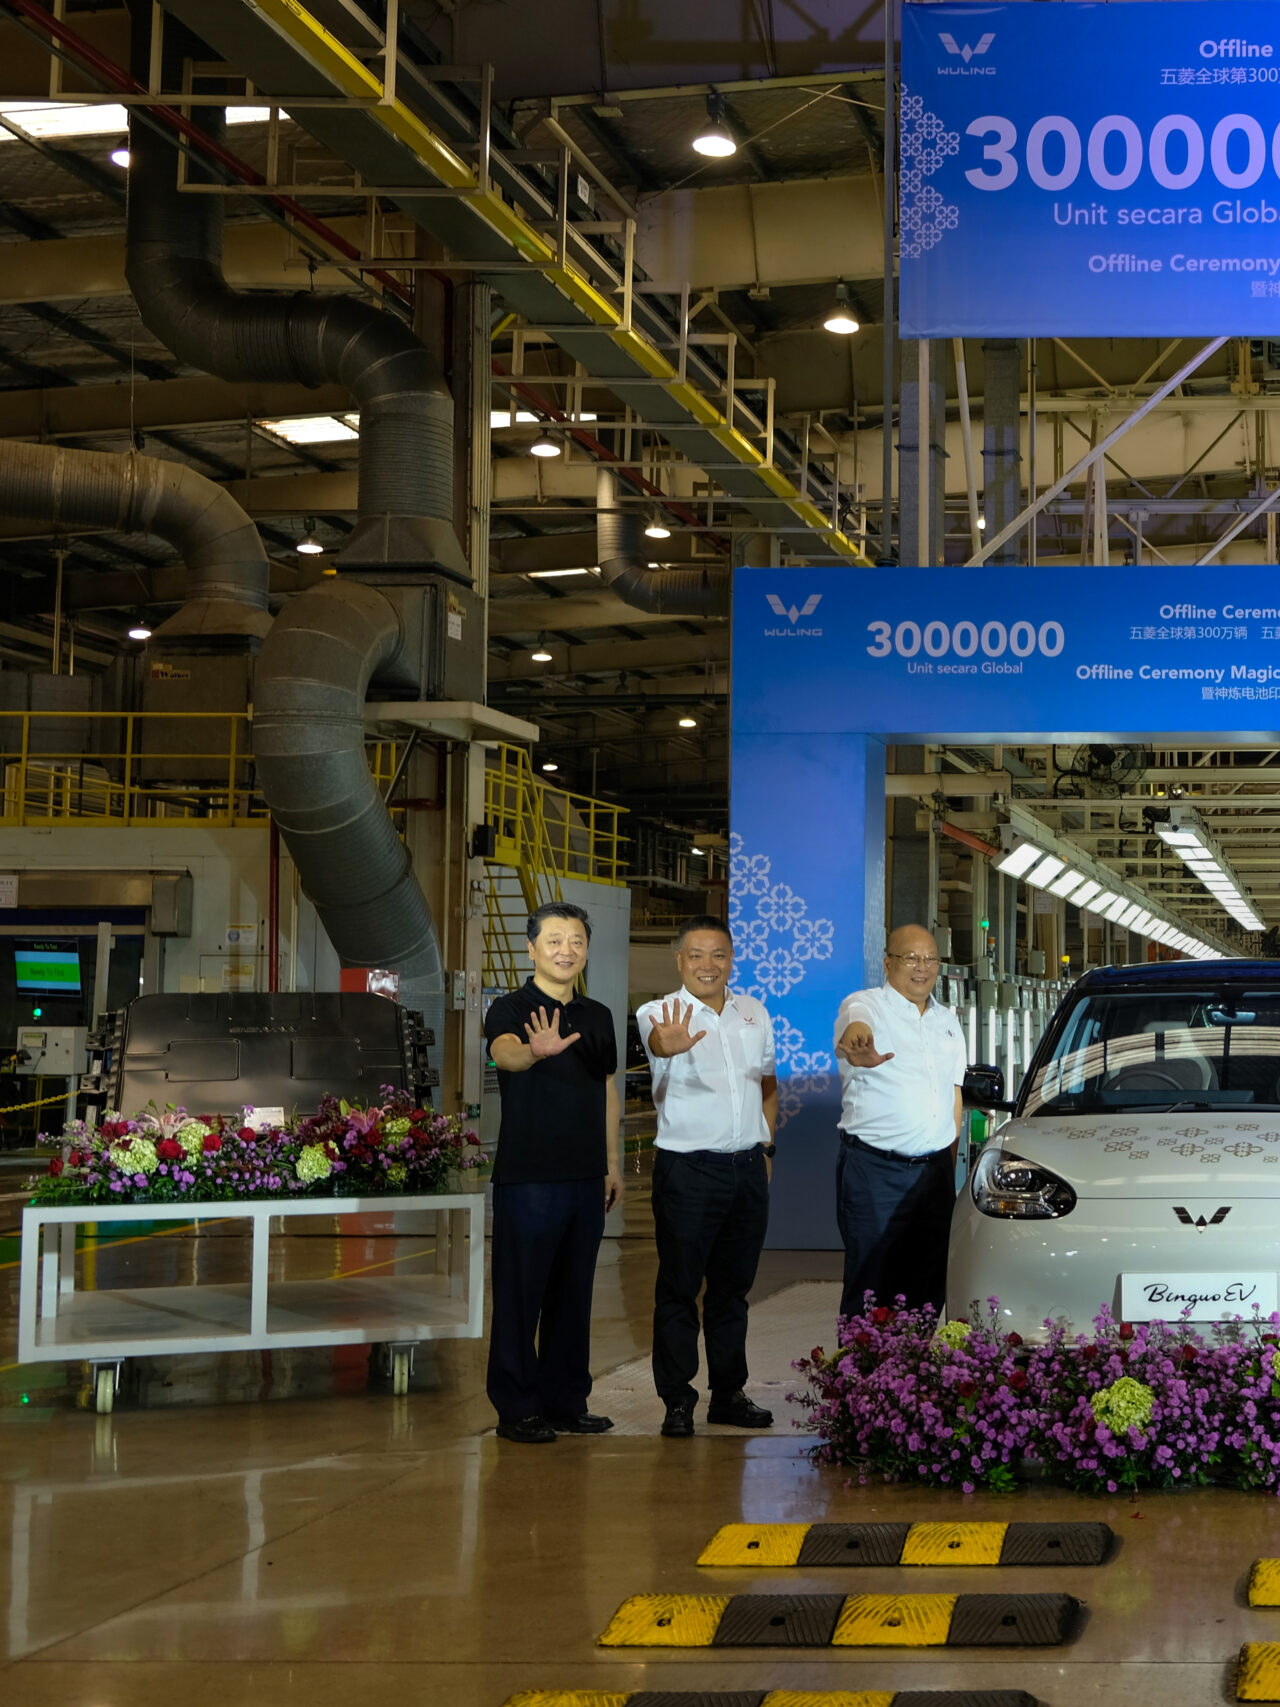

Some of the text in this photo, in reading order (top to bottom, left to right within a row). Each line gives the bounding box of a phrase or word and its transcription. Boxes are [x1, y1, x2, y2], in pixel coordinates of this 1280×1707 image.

[1199, 39, 1273, 58] Offline
[937, 67, 996, 75] WULING
[1053, 203, 1107, 225] Unit
[1117, 207, 1202, 224] secara
[1088, 254, 1163, 272] Offline
[1170, 254, 1280, 275] Ceremony
[1159, 604, 1217, 619] Offline
[764, 628, 823, 637] WULING
[866, 620, 1065, 658] 3000000
[1129, 626, 1248, 640] 五菱全球第300万辆
[907, 662, 1023, 674] Unit secara Global
[1075, 664, 1134, 680] Offline
[1139, 665, 1225, 683] Ceremony
[1230, 665, 1280, 683] Magic
[1143, 1283, 1257, 1310] Binguo EV
